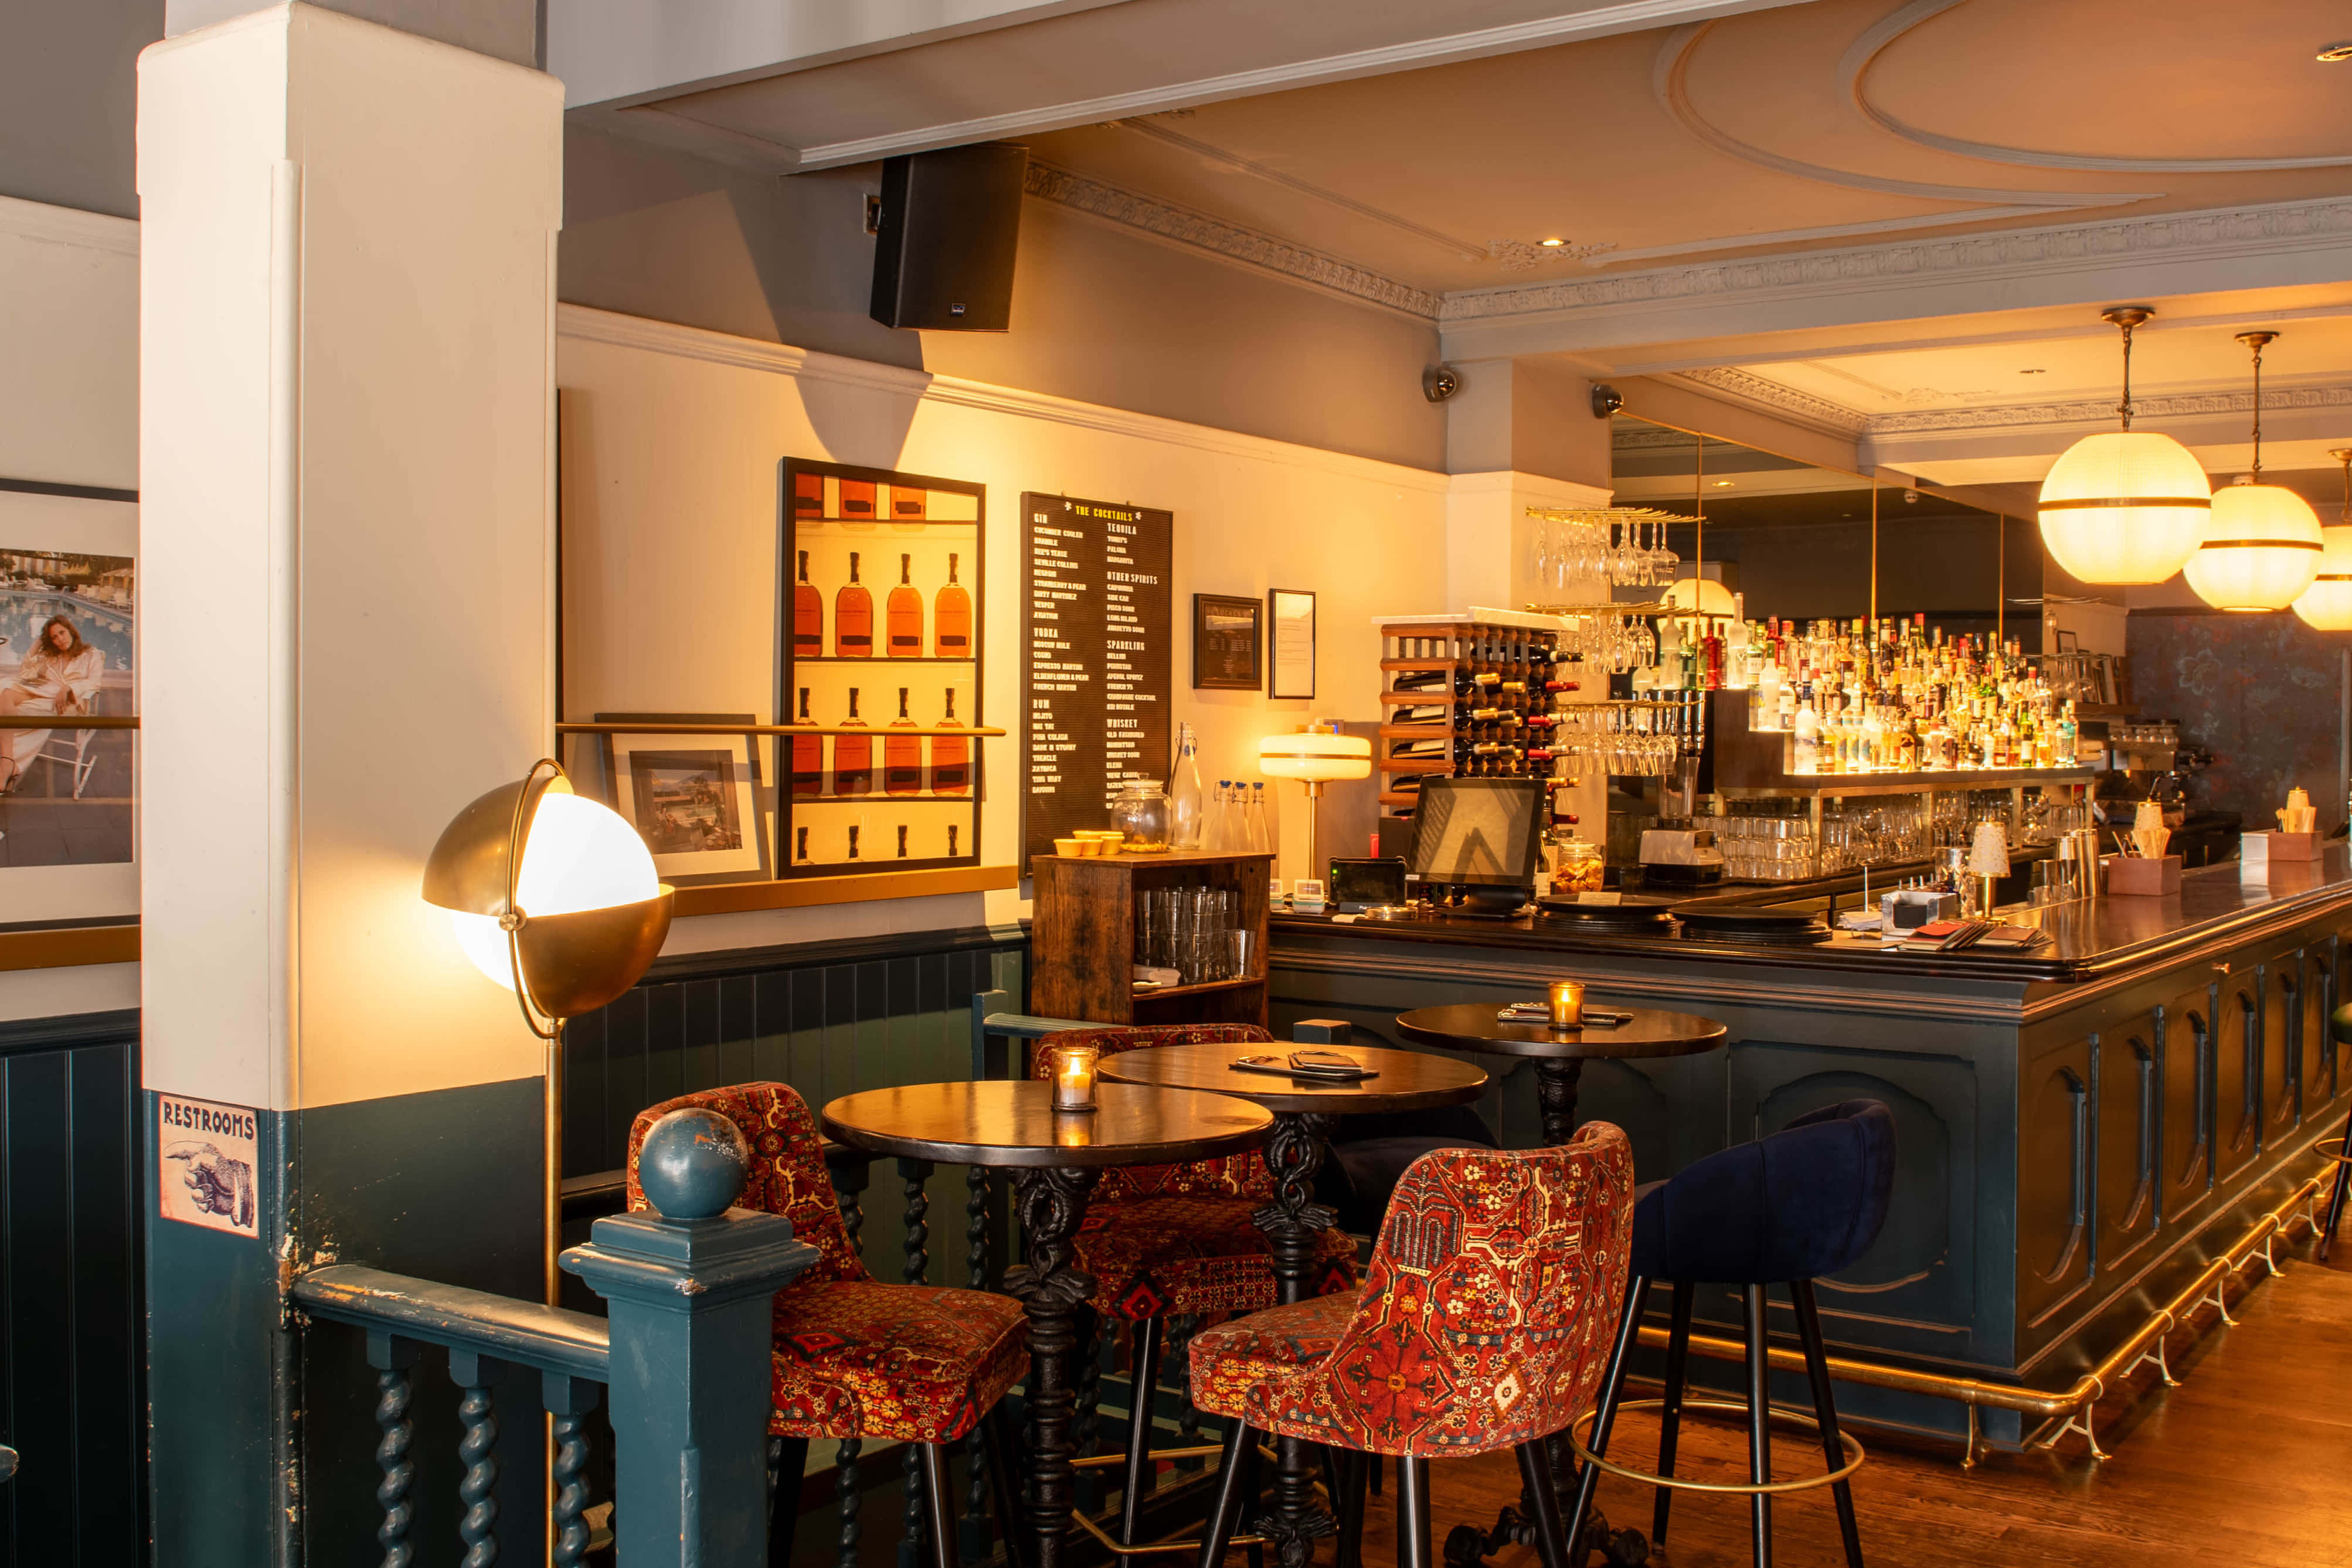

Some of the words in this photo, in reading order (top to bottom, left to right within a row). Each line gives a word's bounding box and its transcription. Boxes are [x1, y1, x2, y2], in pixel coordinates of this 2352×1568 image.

[1034, 513, 1048, 524] GIN
[1076, 505, 1089, 516] THE
[1094, 508, 1133, 522] COCKTAILS
[1034, 526, 1061, 536] CUCUMBER
[1062, 529, 1083, 539] COOLER
[1107, 522, 1137, 535] TEQUILA
[1034, 536, 1058, 546] BRAMBLE
[1107, 545, 1126, 554] PALOMA
[1034, 558, 1056, 567] SEVILLE
[1056, 560, 1079, 569] COLLINS
[1107, 556, 1134, 565] MARGARITA
[1034, 569, 1057, 577] NEGRONI
[1107, 571, 1129, 582] OTHER
[1130, 573, 1158, 585] SPIRITS
[1034, 579, 1067, 589] STRAWBERRY
[1072, 583, 1087, 591] PEAR
[1034, 590, 1050, 598] DIRTY
[1034, 600, 1055, 609] VESPER
[1034, 611, 1059, 620] AVIATION
[1034, 627, 1058, 638] VODKA
[1034, 640, 1055, 649] MOSCOW
[1056, 641, 1070, 649] MULE
[1107, 640, 1145, 651] SPARKLING
[1034, 661, 1061, 670] ESPRESSO
[1062, 663, 1083, 671] MARTINI
[1034, 672, 1070, 681] ELDERFLOWER
[1056, 683, 1077, 692] MARTINI
[1034, 699, 1050, 709] RUM
[1107, 718, 1138, 728] WHISKEY
[164, 1101, 254, 1140] RESTROOMS
